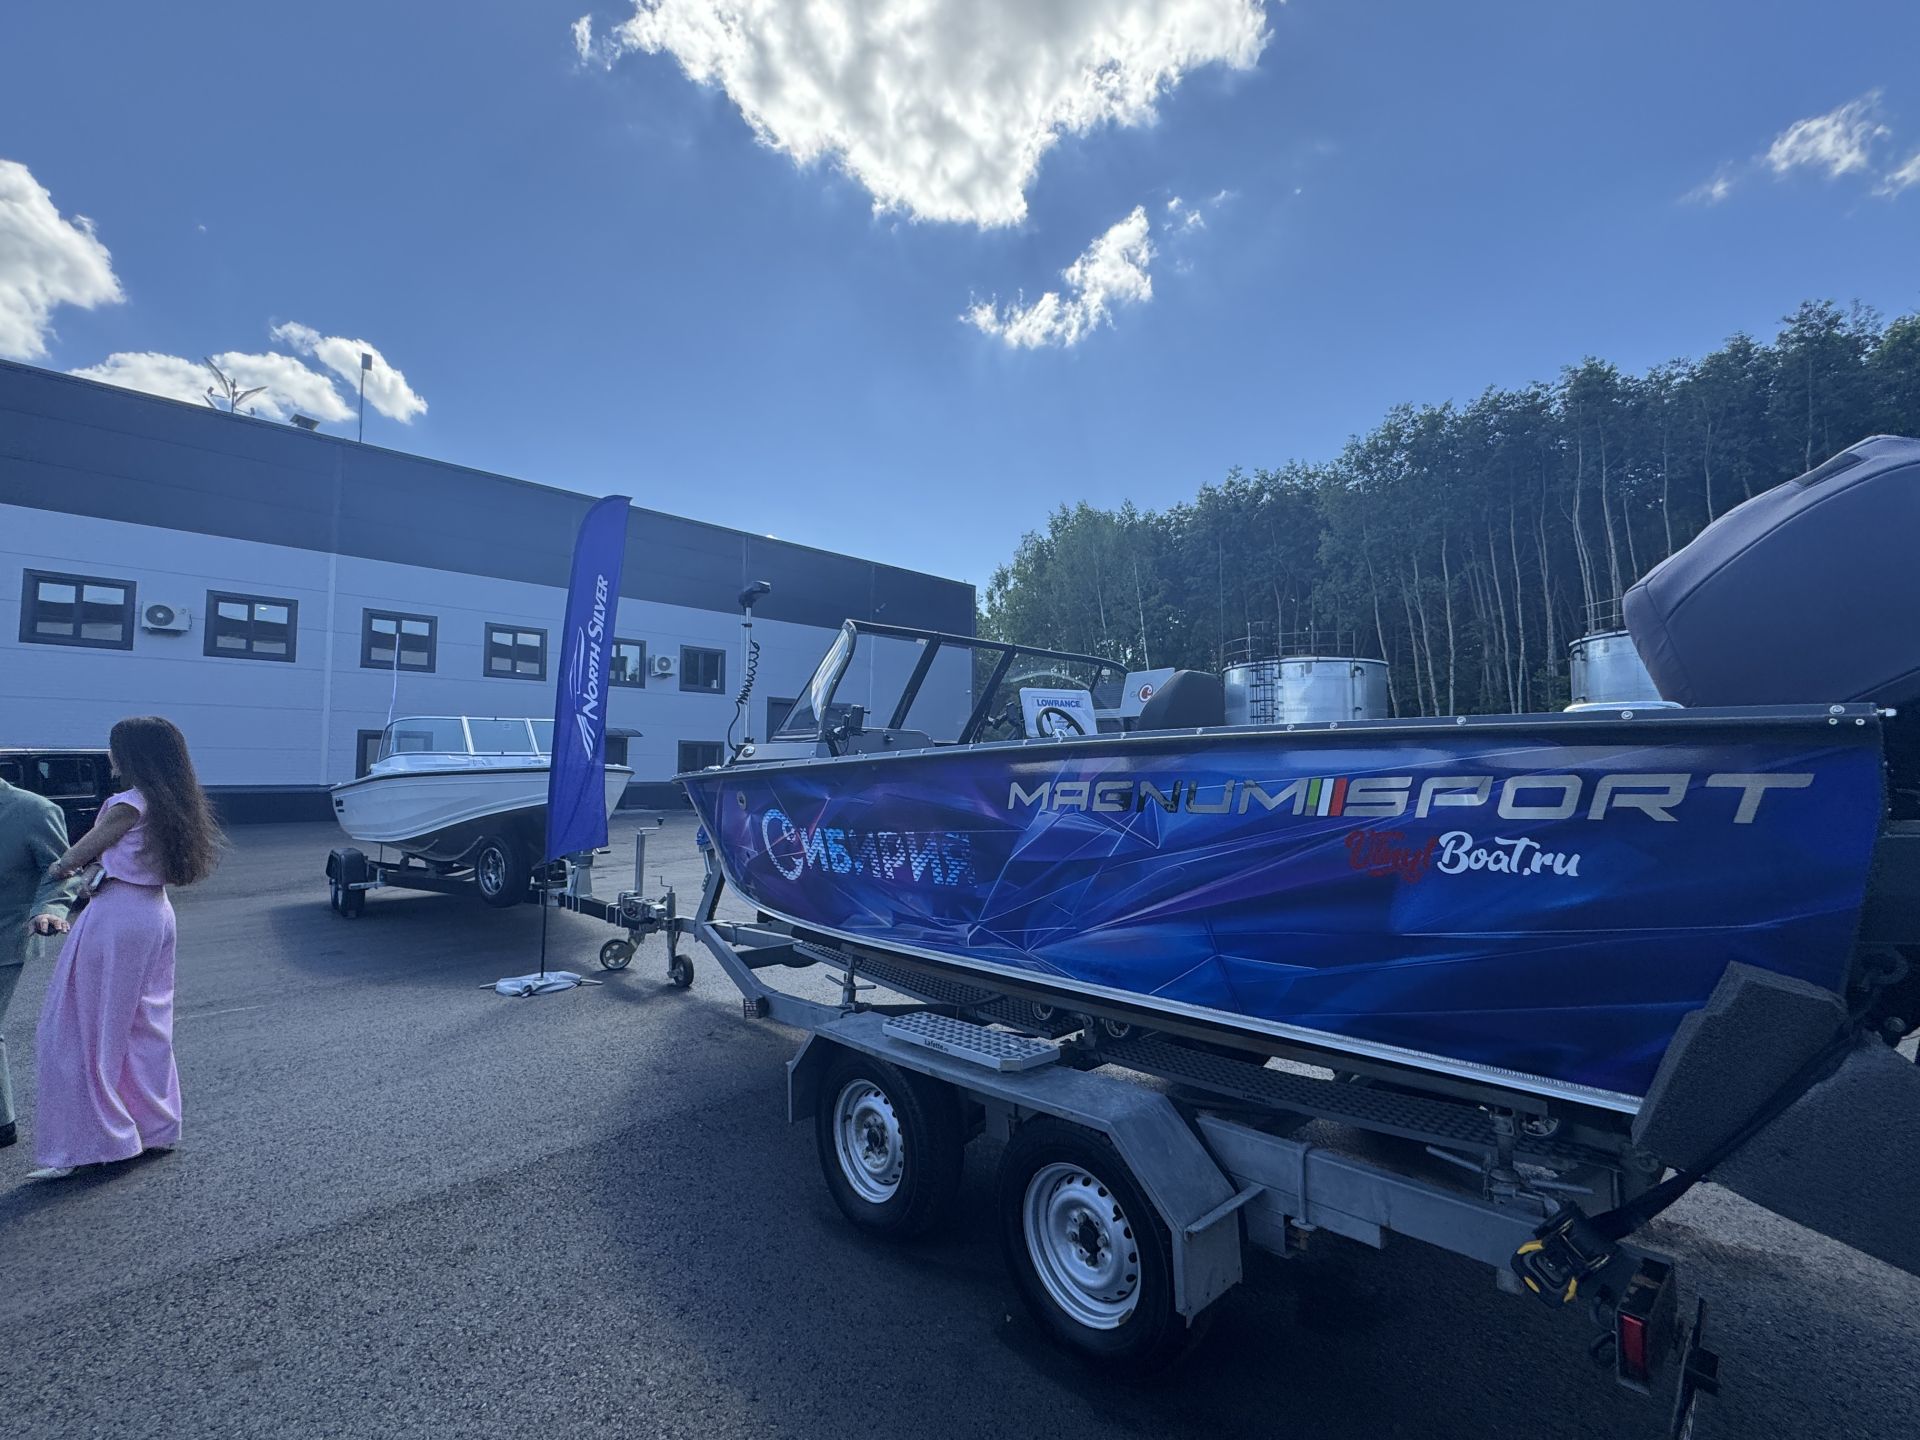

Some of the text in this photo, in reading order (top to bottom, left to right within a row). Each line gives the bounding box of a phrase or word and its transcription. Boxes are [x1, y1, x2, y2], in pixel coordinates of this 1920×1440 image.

[1036, 698, 1081, 708] LOWRANCE
[1007, 773, 1815, 823] MAGNUM SPORT
